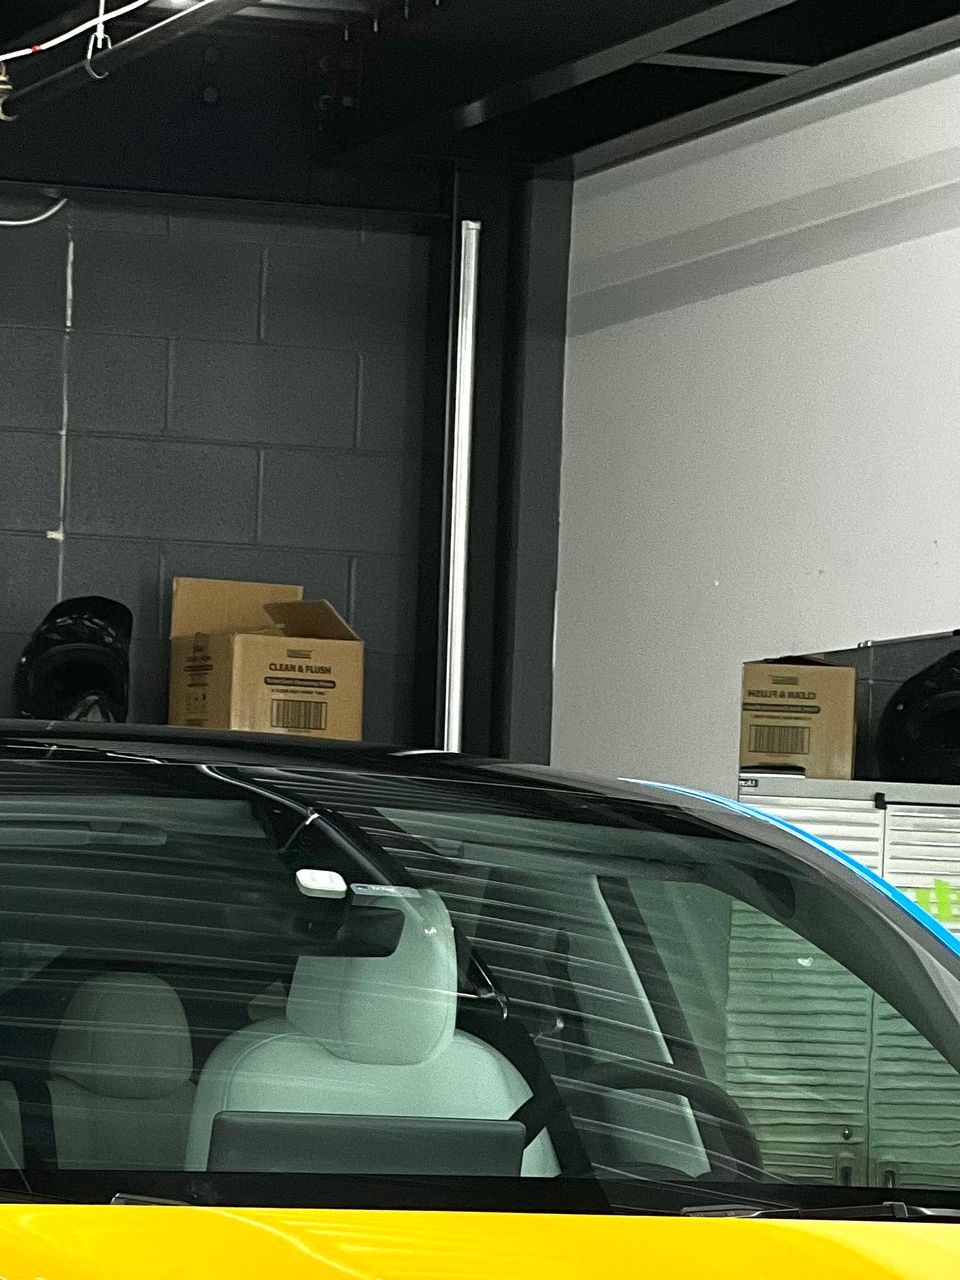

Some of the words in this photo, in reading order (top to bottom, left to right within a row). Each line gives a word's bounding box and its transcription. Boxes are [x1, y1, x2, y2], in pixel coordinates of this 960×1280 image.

[269, 663, 296, 673] CLEAN
[297, 665, 304, 673] &
[305, 665, 331, 674] FLUSH
